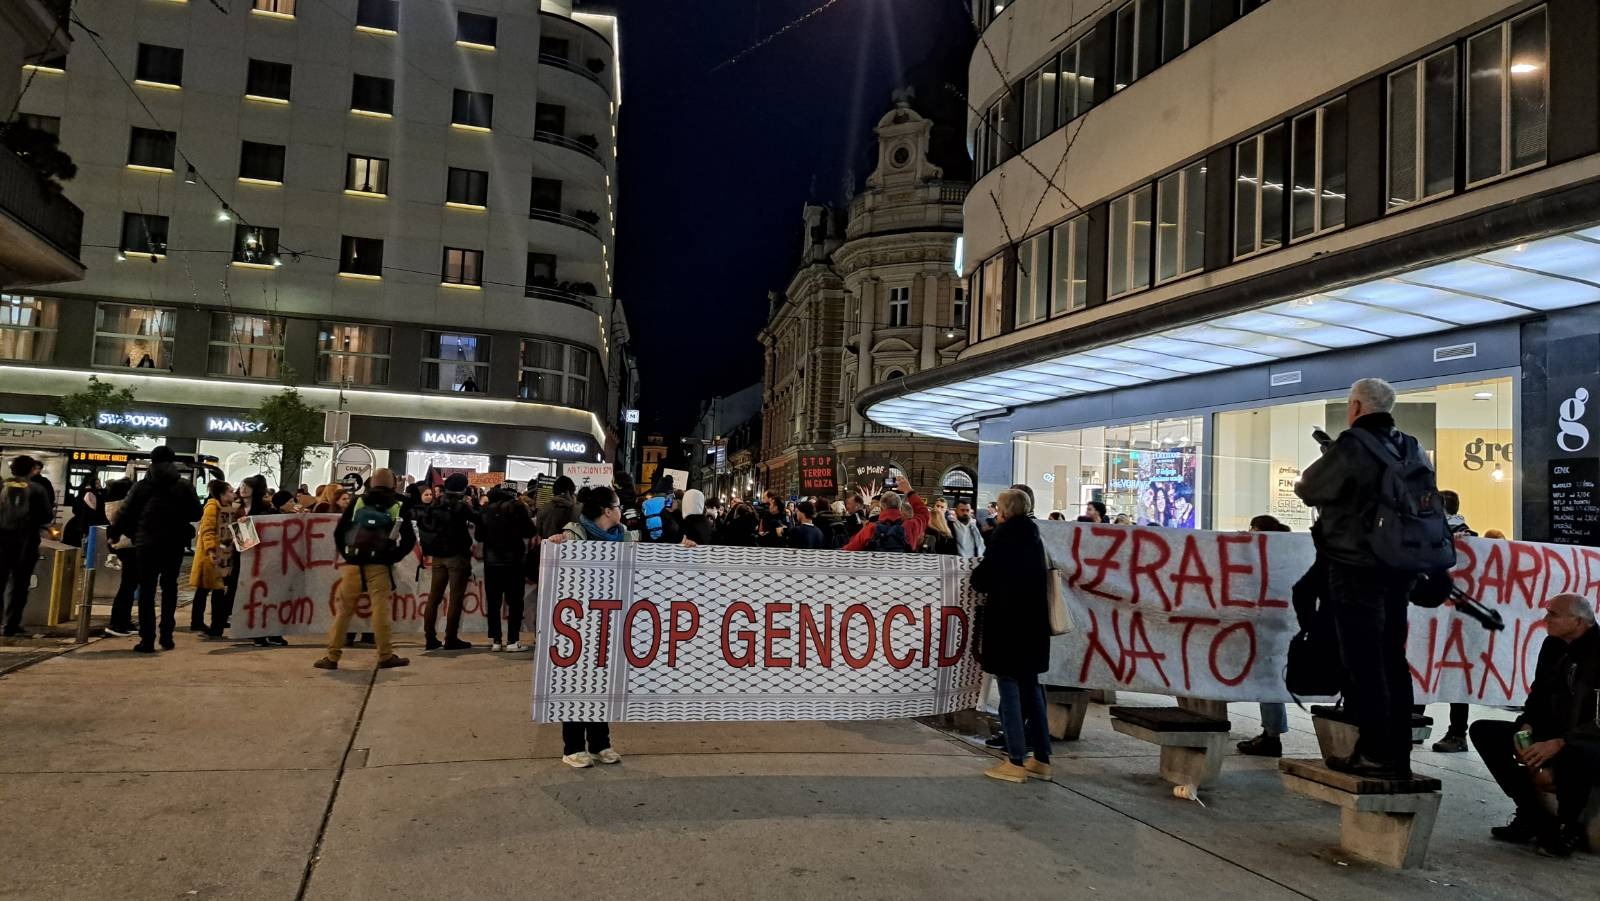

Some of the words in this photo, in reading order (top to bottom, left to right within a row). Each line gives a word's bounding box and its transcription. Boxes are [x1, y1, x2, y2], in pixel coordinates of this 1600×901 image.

[1557, 387, 1590, 452] g
[424, 432, 479, 445] MANGO
[550, 441, 586, 453] MANGO
[802, 456, 831, 466] STOP
[803, 468, 832, 478] TERROR
[857, 467, 865, 475] NO
[814, 480, 833, 488] GAZA
[1278, 479, 1294, 487] FIN
[251, 518, 345, 577] FRE
[1068, 526, 1289, 612] IZRAEL
[243, 580, 314, 629] from
[549, 598, 700, 669] STOP
[721, 602, 969, 669] GENOCID
[1079, 608, 1256, 690] NATO
